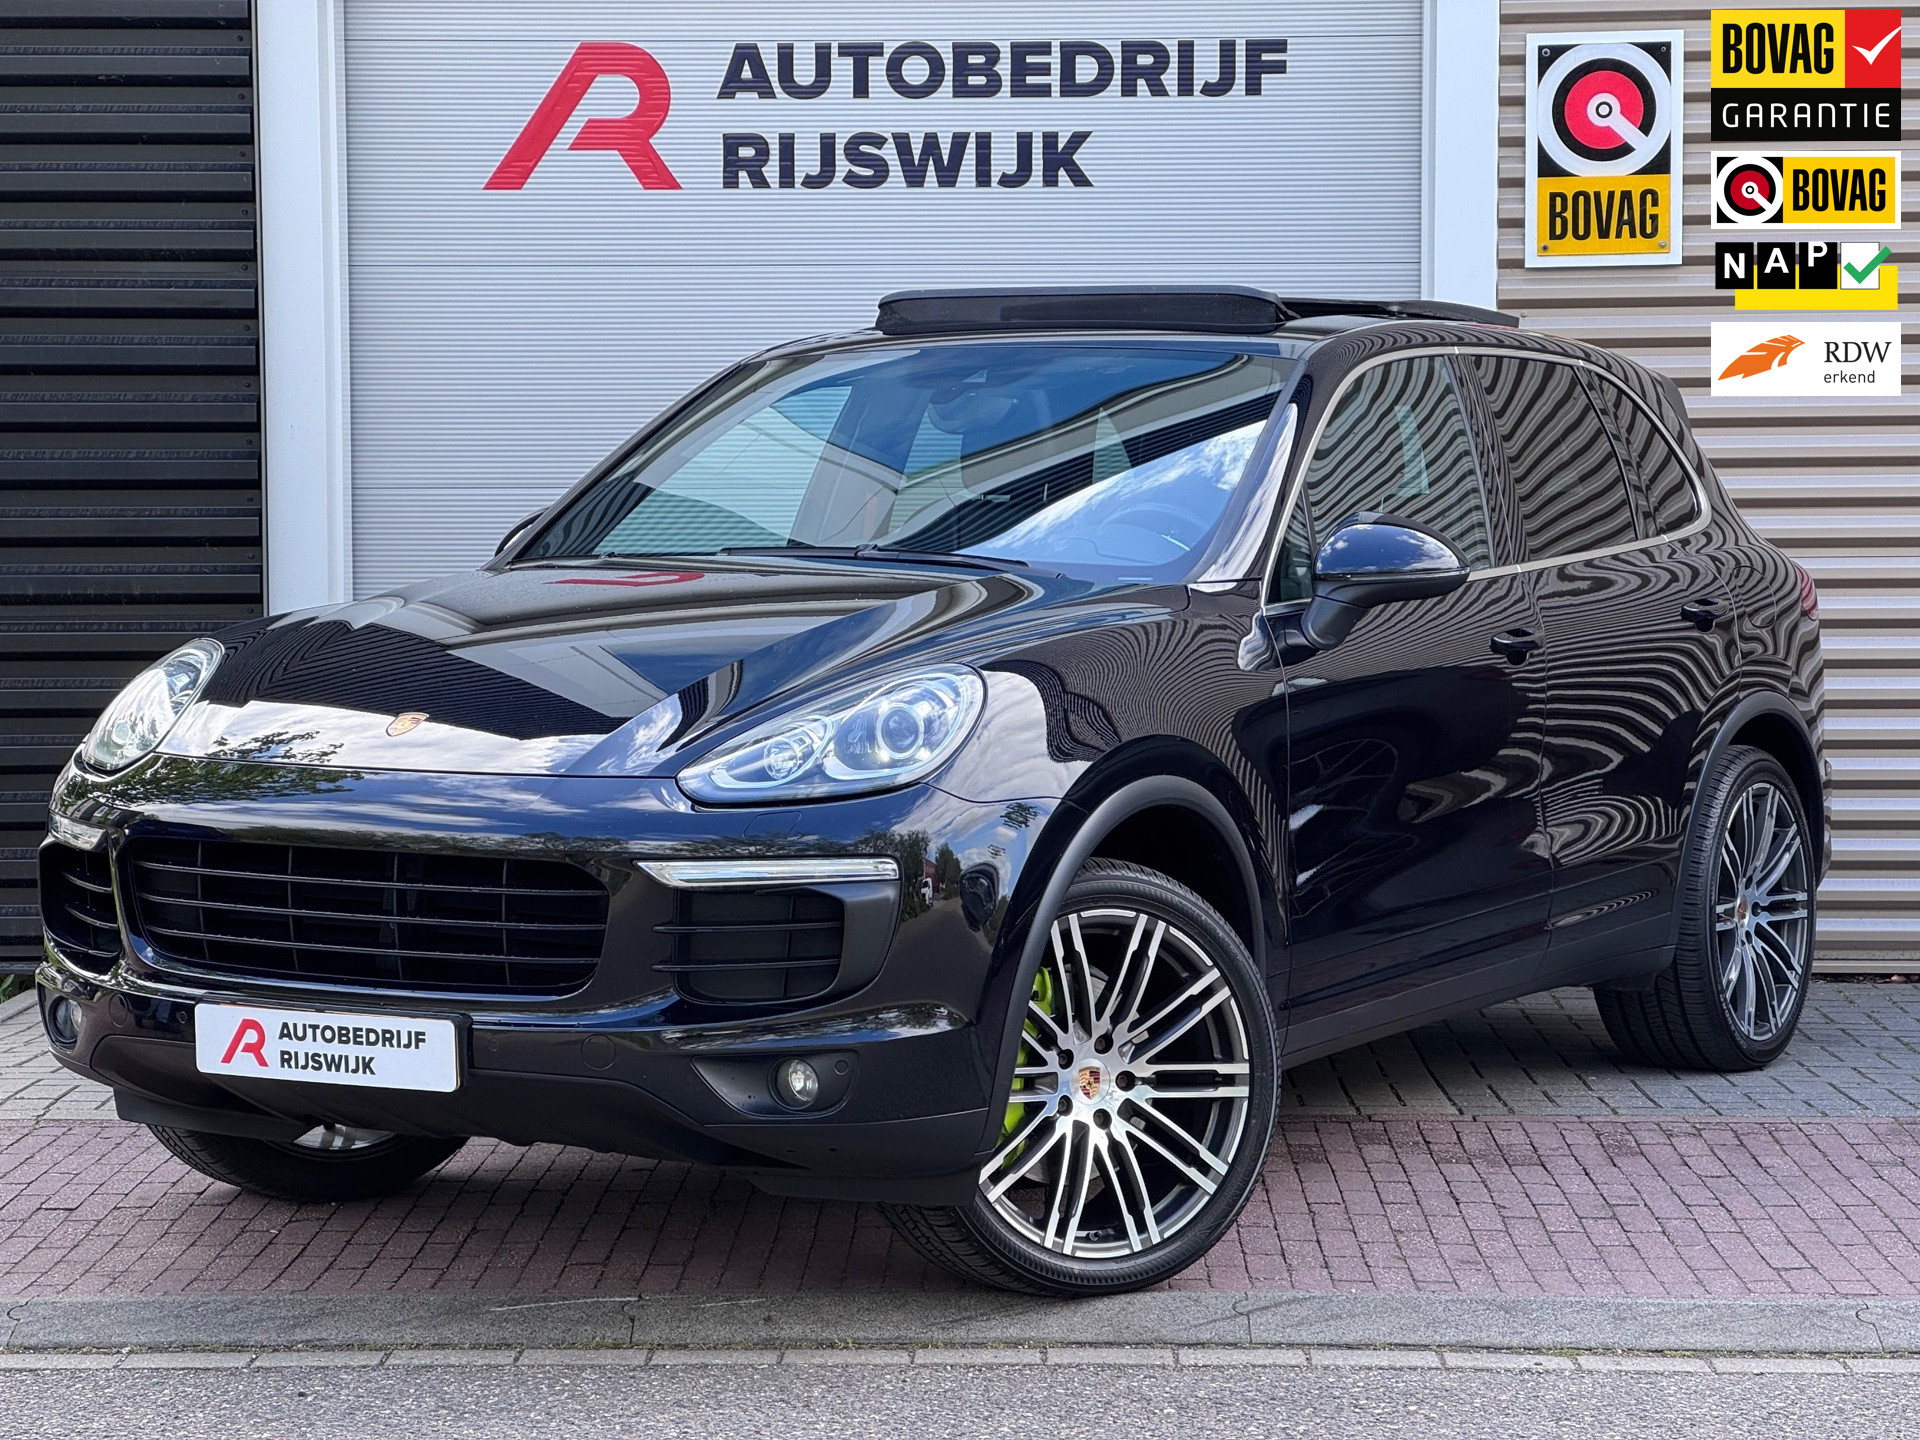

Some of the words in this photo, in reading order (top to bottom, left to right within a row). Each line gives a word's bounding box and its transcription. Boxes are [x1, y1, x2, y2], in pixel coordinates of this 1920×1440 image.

[717, 38, 1288, 99] AUTOBEDRIJF
[722, 131, 1094, 189] RIJSWIJK
[1548, 188, 1660, 241] BOVAG
[278, 1021, 426, 1049] AUTOBEDRIJF
[279, 1050, 376, 1075] RIJSWIJK
